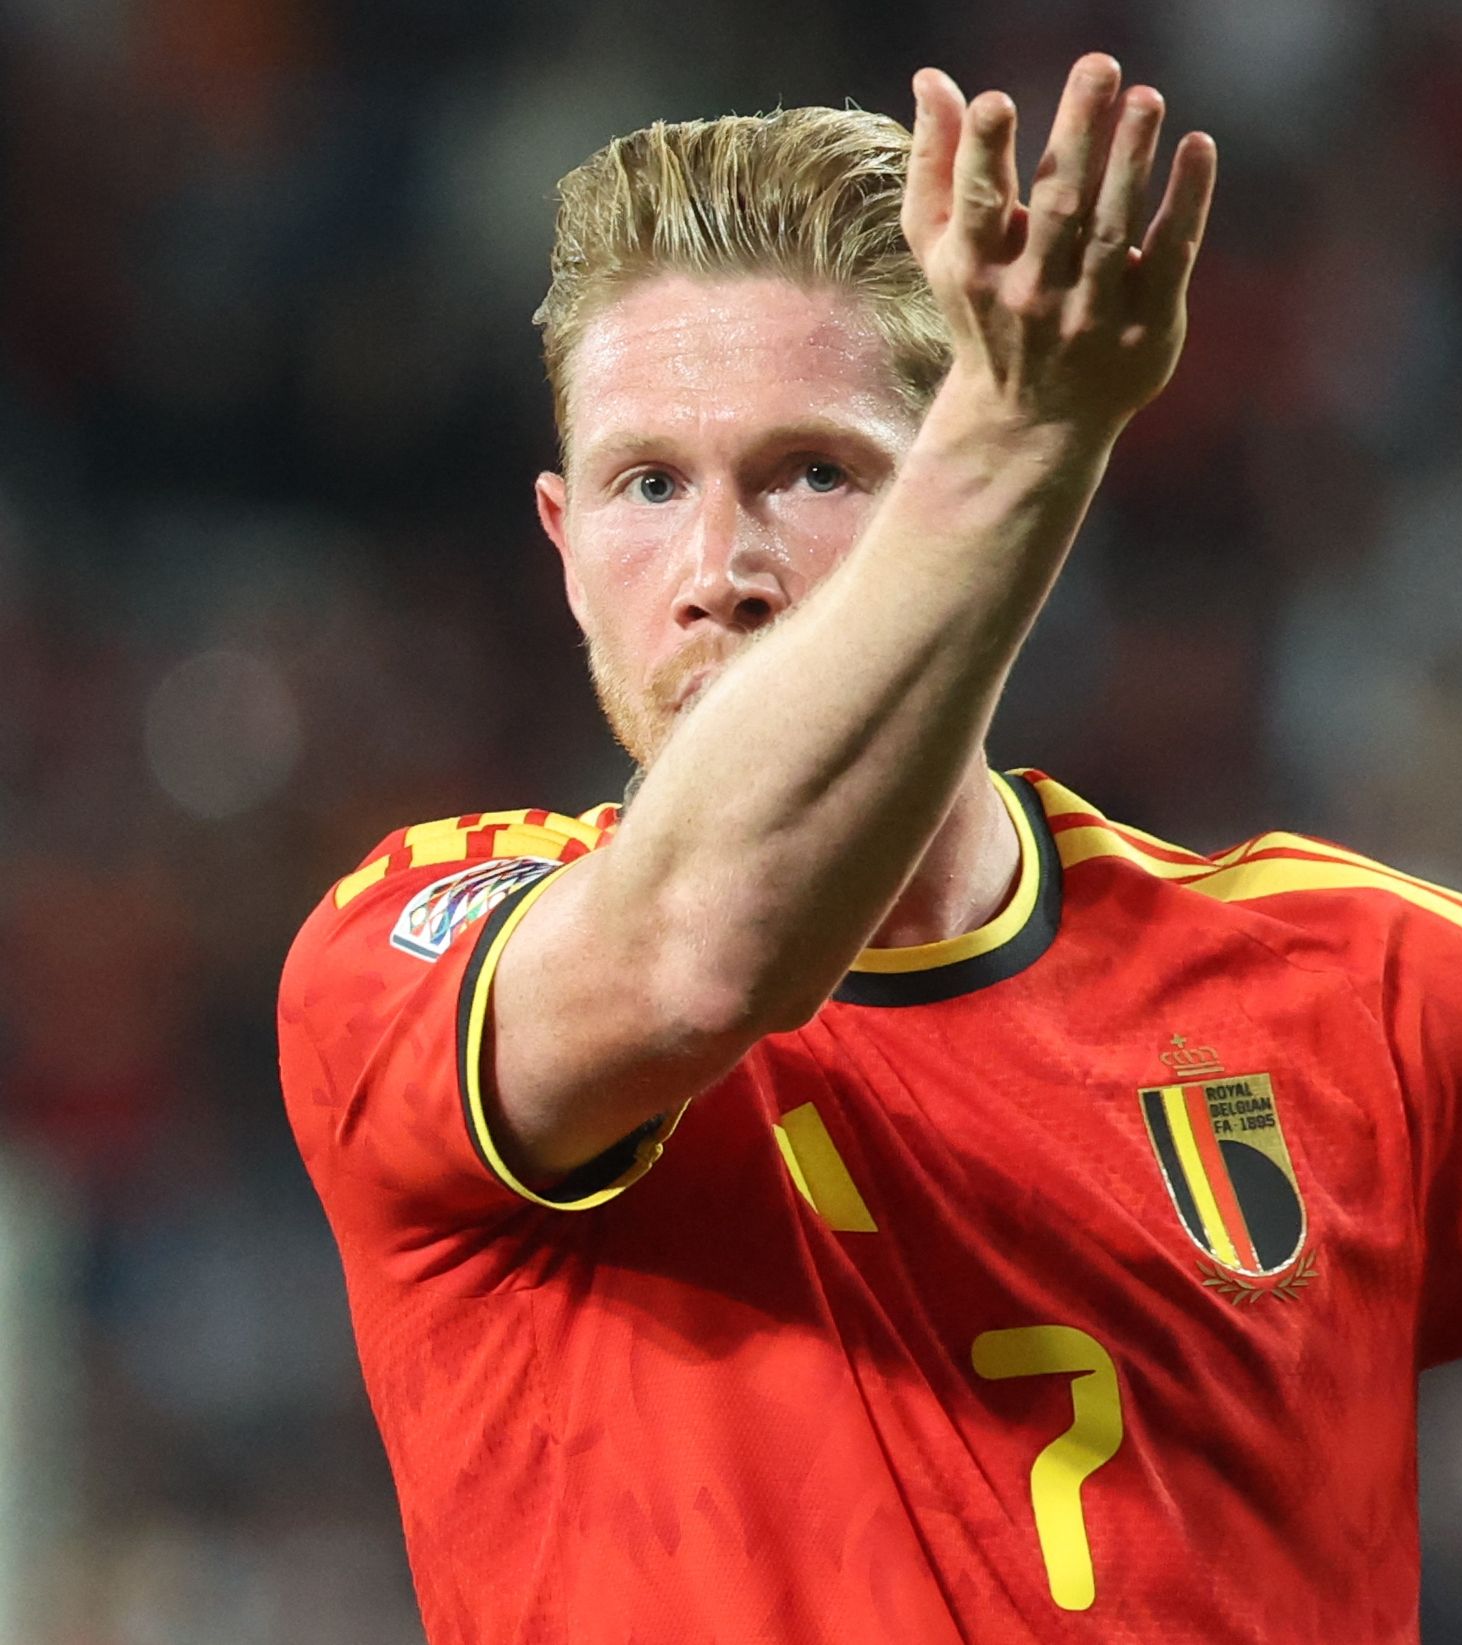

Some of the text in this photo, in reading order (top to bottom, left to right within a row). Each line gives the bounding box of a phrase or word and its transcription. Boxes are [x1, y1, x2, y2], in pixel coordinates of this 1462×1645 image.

[1206, 1082, 1253, 1101] ROYAL
[1210, 1097, 1272, 1117] BELGIAN
[1214, 1119, 1233, 1133] FA
[971, 1324, 1124, 1611] 7
